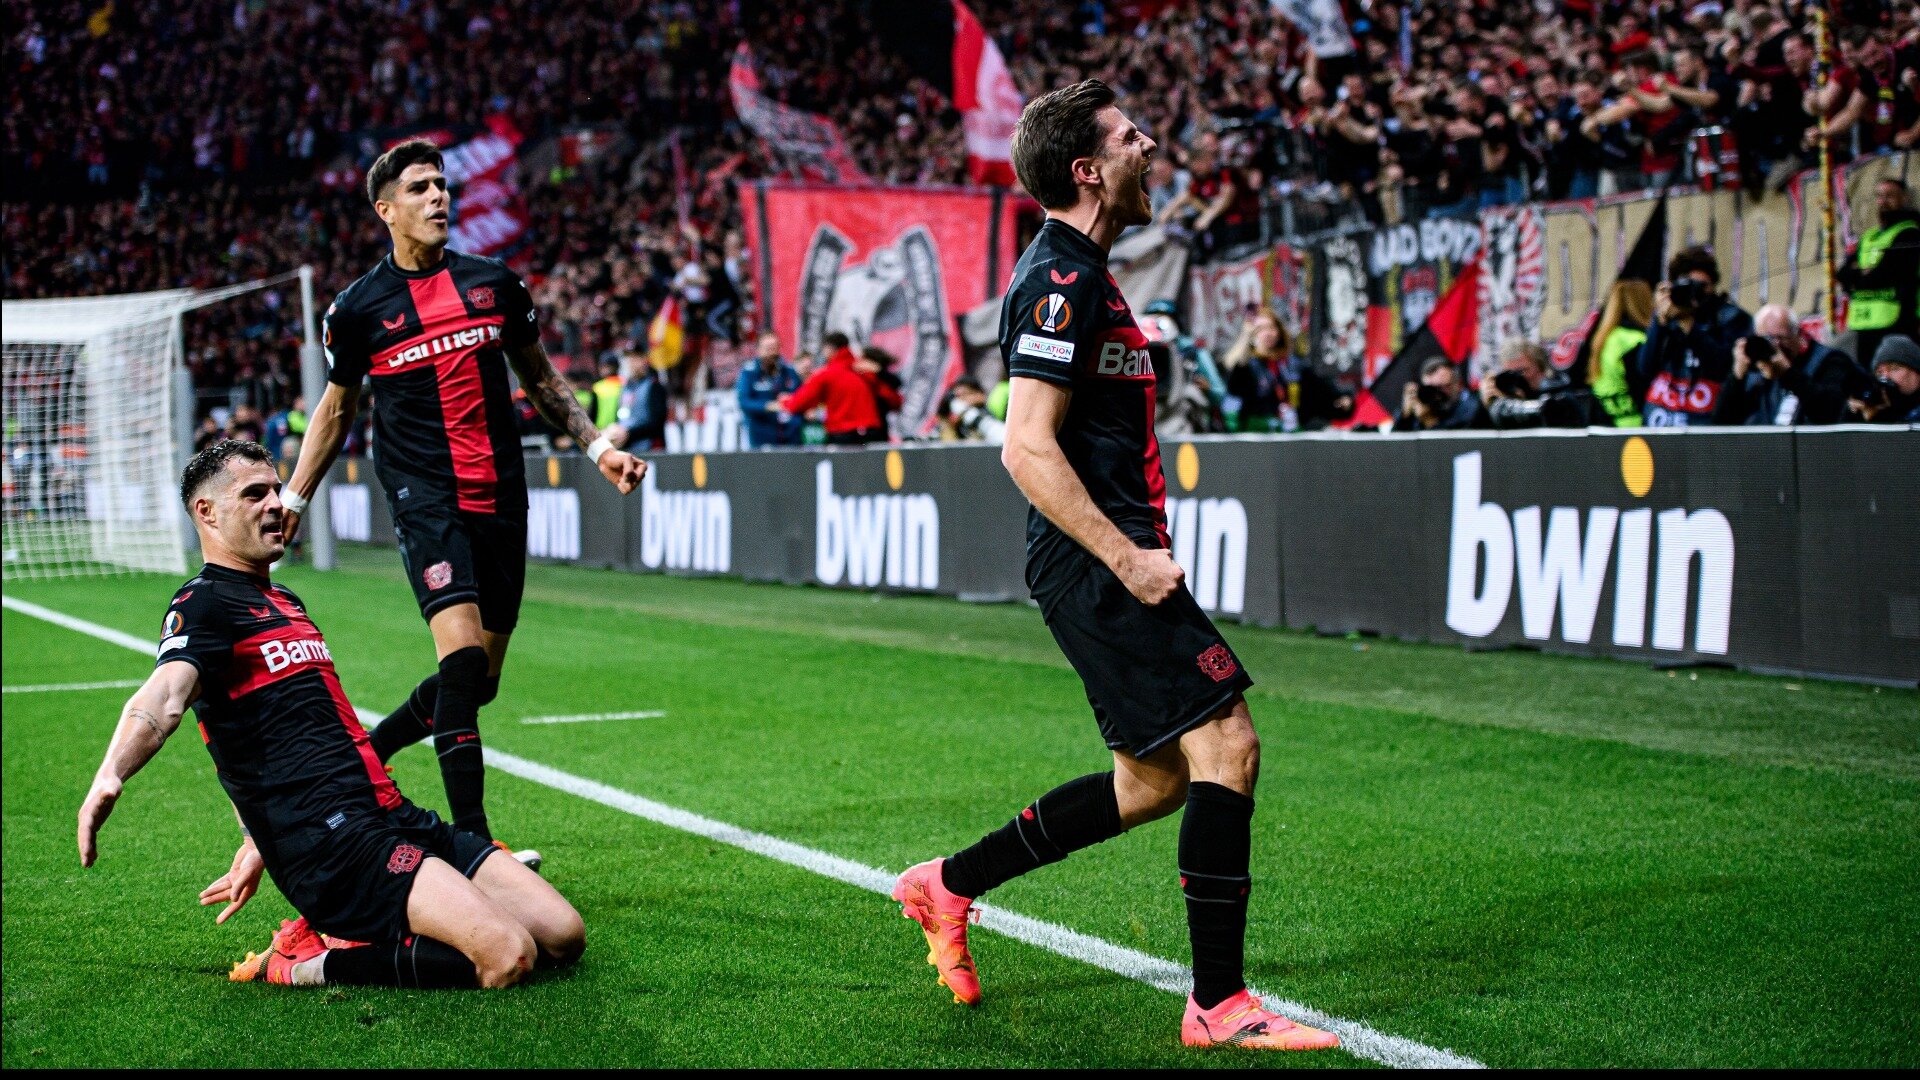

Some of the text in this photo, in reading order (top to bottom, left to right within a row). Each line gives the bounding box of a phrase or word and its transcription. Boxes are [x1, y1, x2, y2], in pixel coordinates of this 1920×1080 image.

[527, 455, 580, 560] win
[641, 453, 731, 572] bwin
[815, 449, 940, 590] bwin
[1446, 436, 1735, 655] bwin
